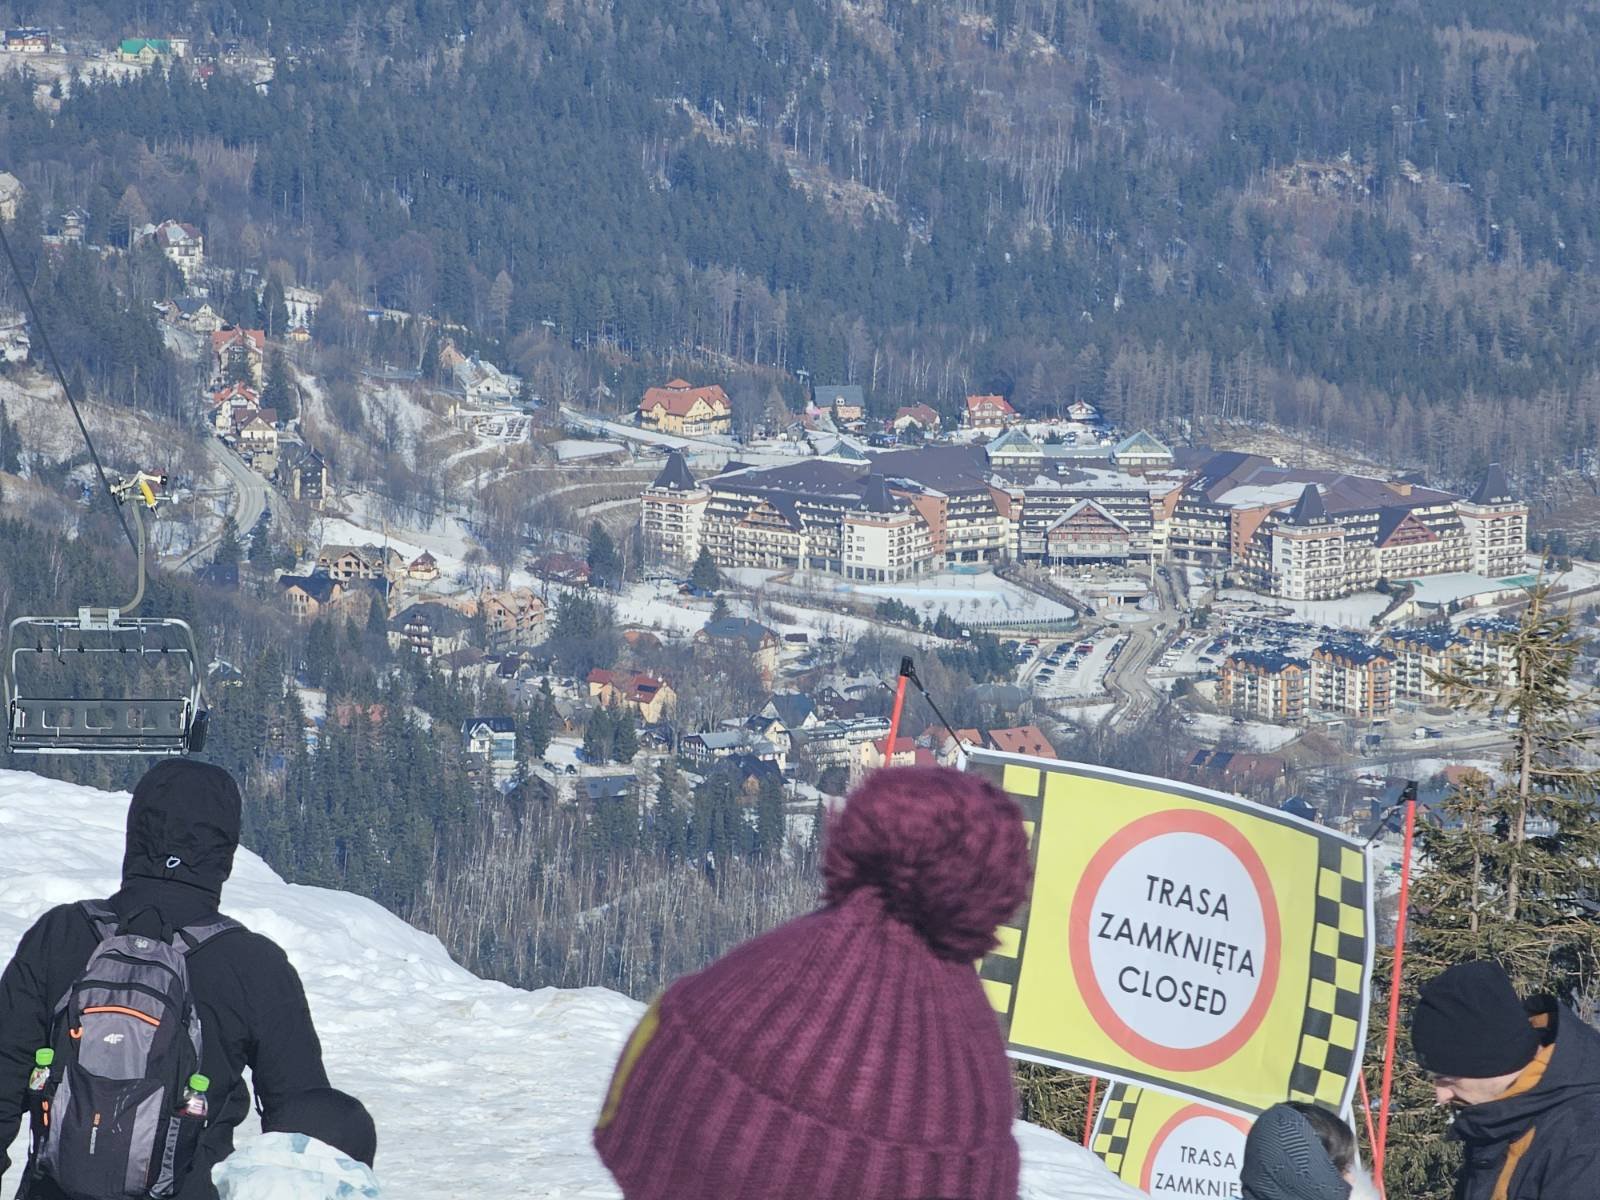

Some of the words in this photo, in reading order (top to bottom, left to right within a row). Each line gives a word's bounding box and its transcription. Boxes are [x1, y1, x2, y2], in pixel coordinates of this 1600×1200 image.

[1146, 874, 1230, 922] TRASA
[1097, 912, 1255, 978] ZAMKNIĘTA
[1118, 965, 1227, 1016] CLOSED
[103, 1033, 124, 1044] 4F
[1180, 1145, 1237, 1170] TRASA
